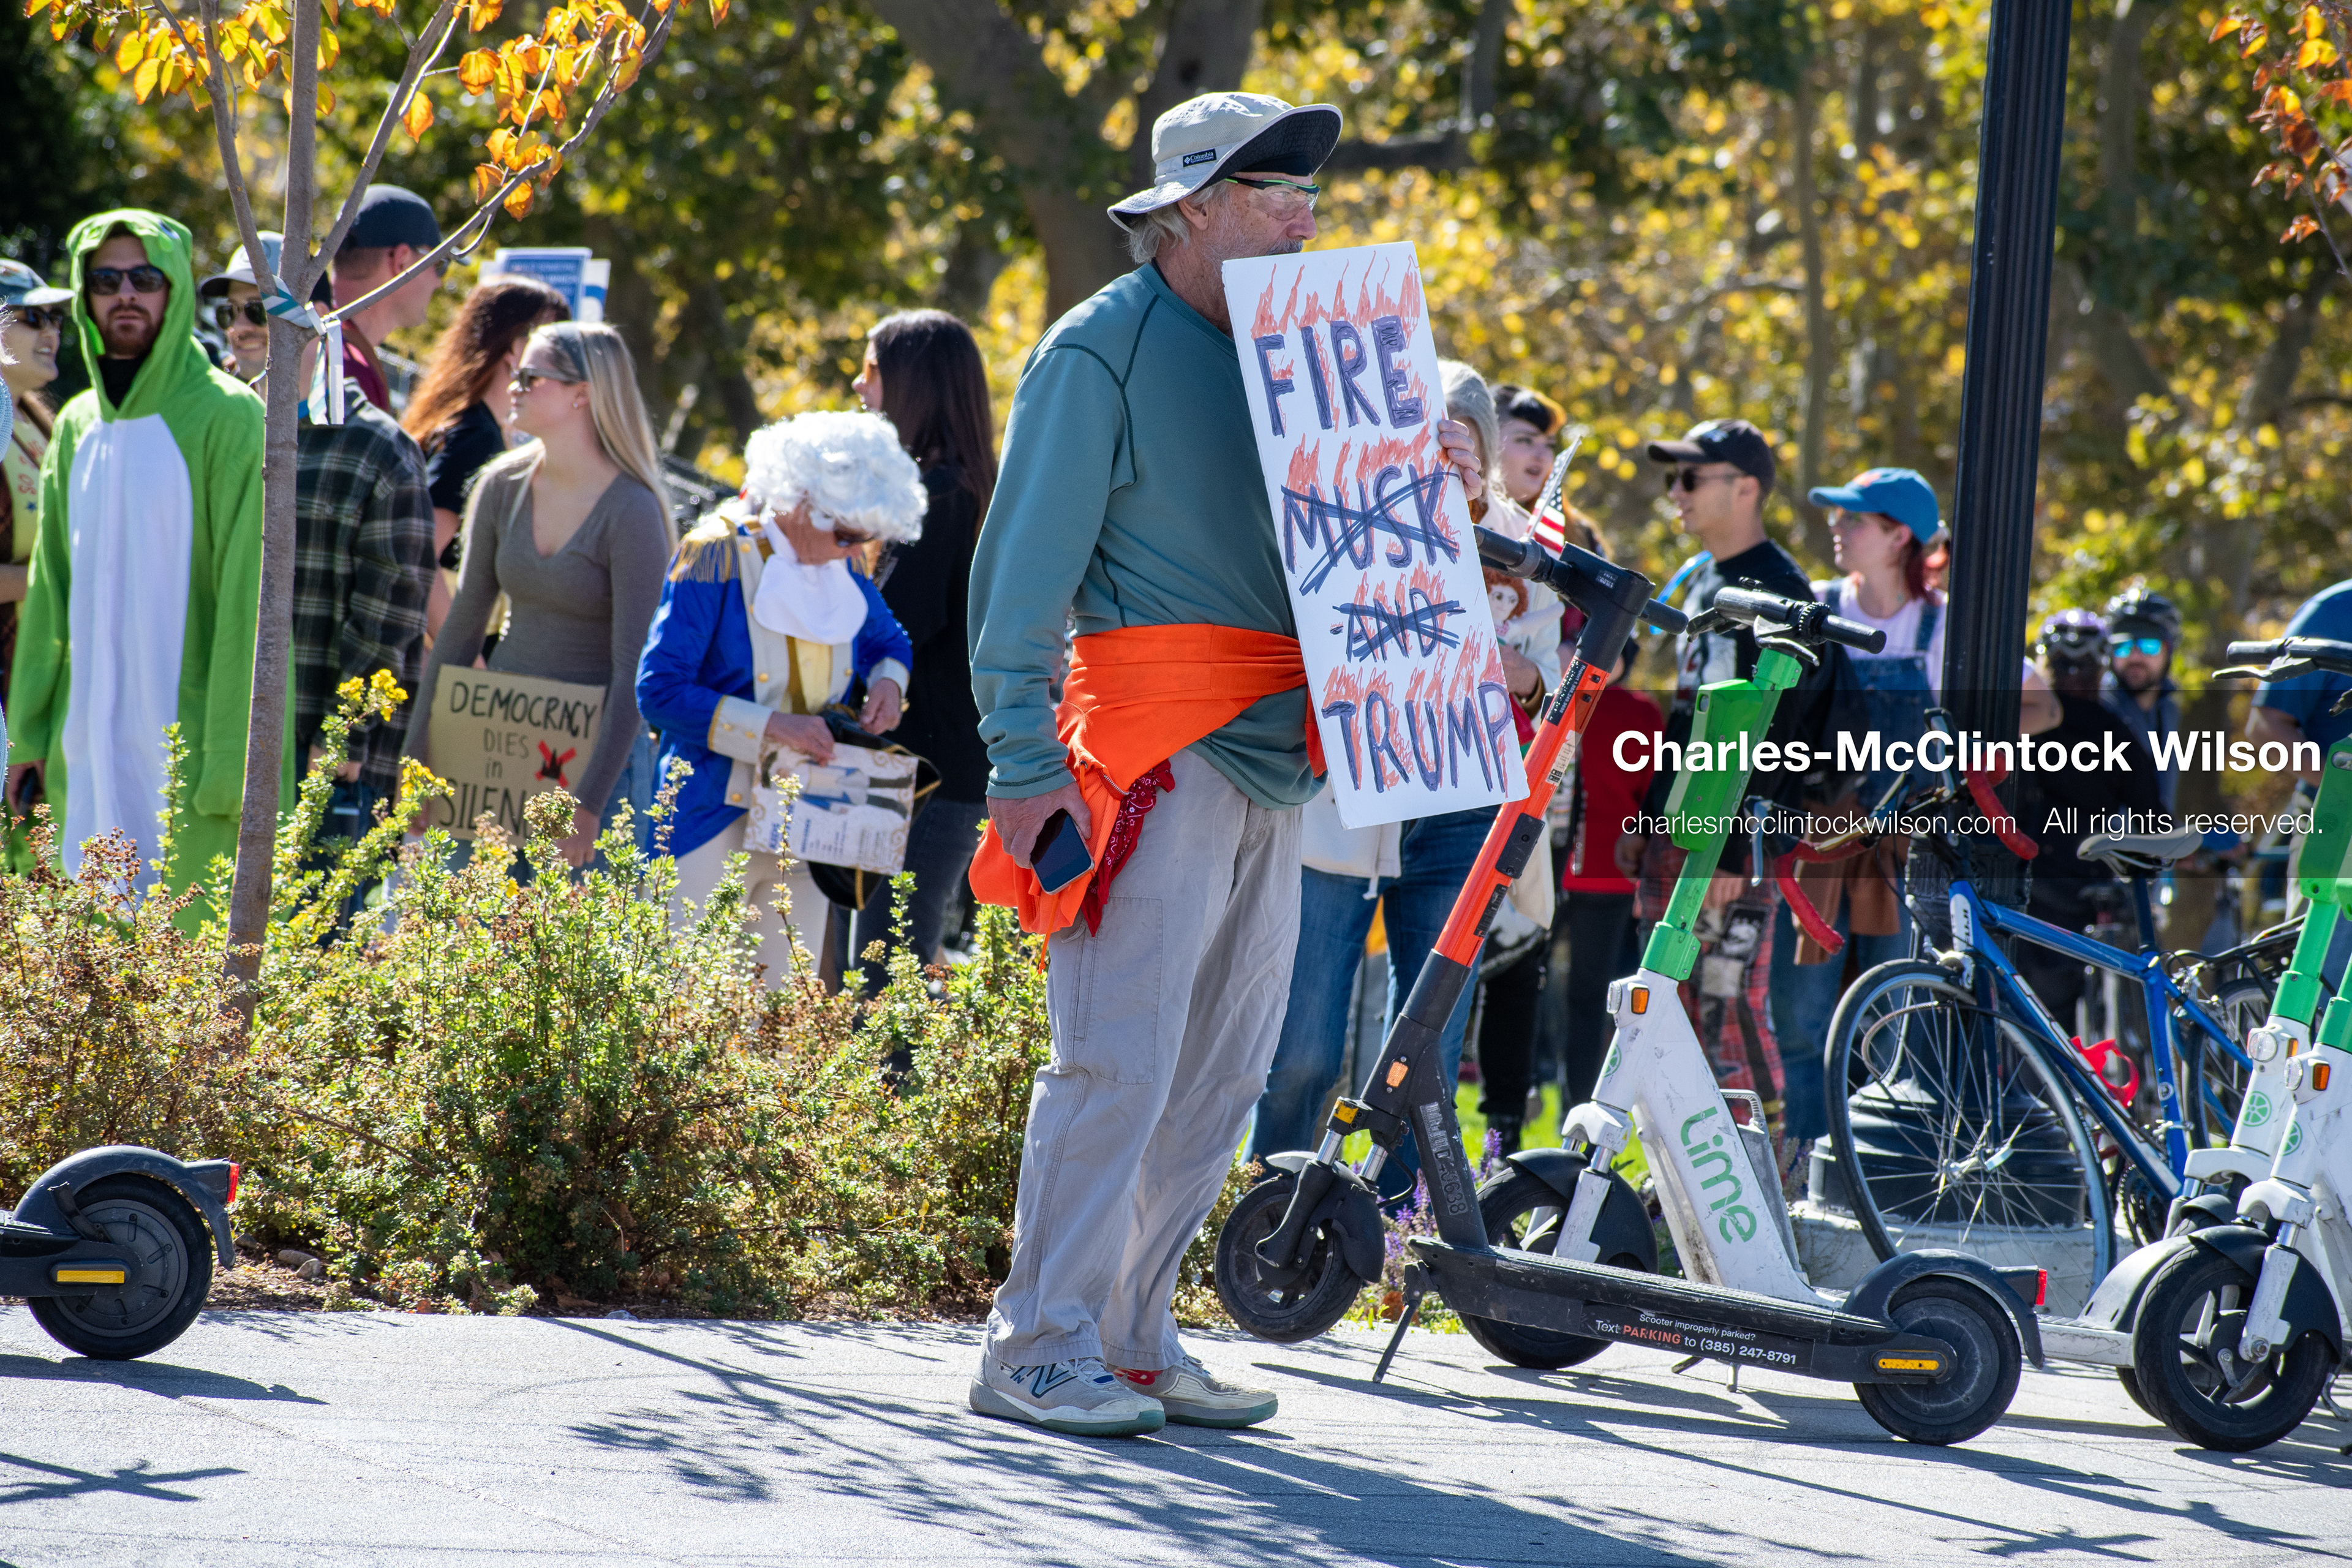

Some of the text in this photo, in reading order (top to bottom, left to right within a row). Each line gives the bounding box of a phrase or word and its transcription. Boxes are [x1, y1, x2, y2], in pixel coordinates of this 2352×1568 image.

[1190, 151, 1214, 161] Columbia
[1254, 314, 1425, 439] FIRE
[1280, 461, 1459, 576] MUSK
[450, 680, 597, 739] DEMOCRACY
[483, 727, 529, 760] DIES
[1321, 681, 1513, 793] TRUMP
[485, 758, 503, 779] in
[1680, 1106, 1757, 1245] Lime
[1595, 1319, 1797, 1365] Text PARKING to (385) 247-8791
[1639, 1313, 1756, 1341] Scooter improperly parked?
